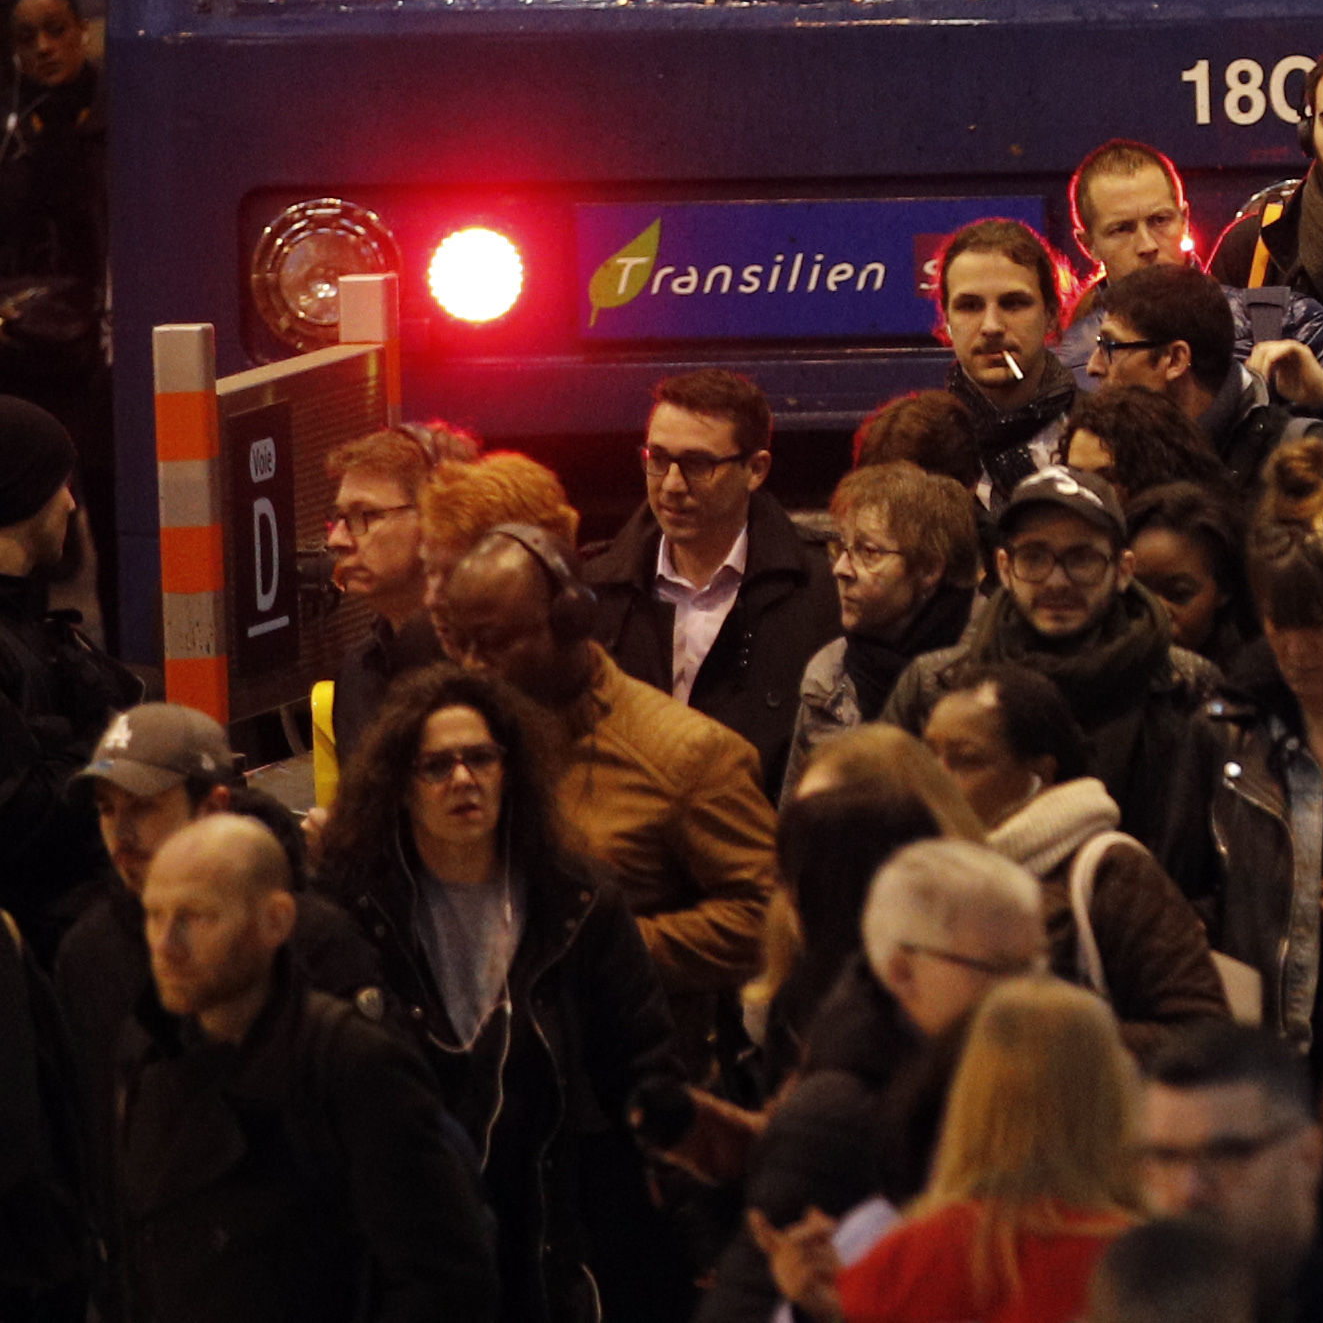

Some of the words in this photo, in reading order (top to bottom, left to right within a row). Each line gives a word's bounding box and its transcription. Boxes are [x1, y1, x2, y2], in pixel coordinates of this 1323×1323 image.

[616, 252, 886, 295] Transilien
[252, 445, 272, 476] Voie
[253, 497, 279, 612] D
